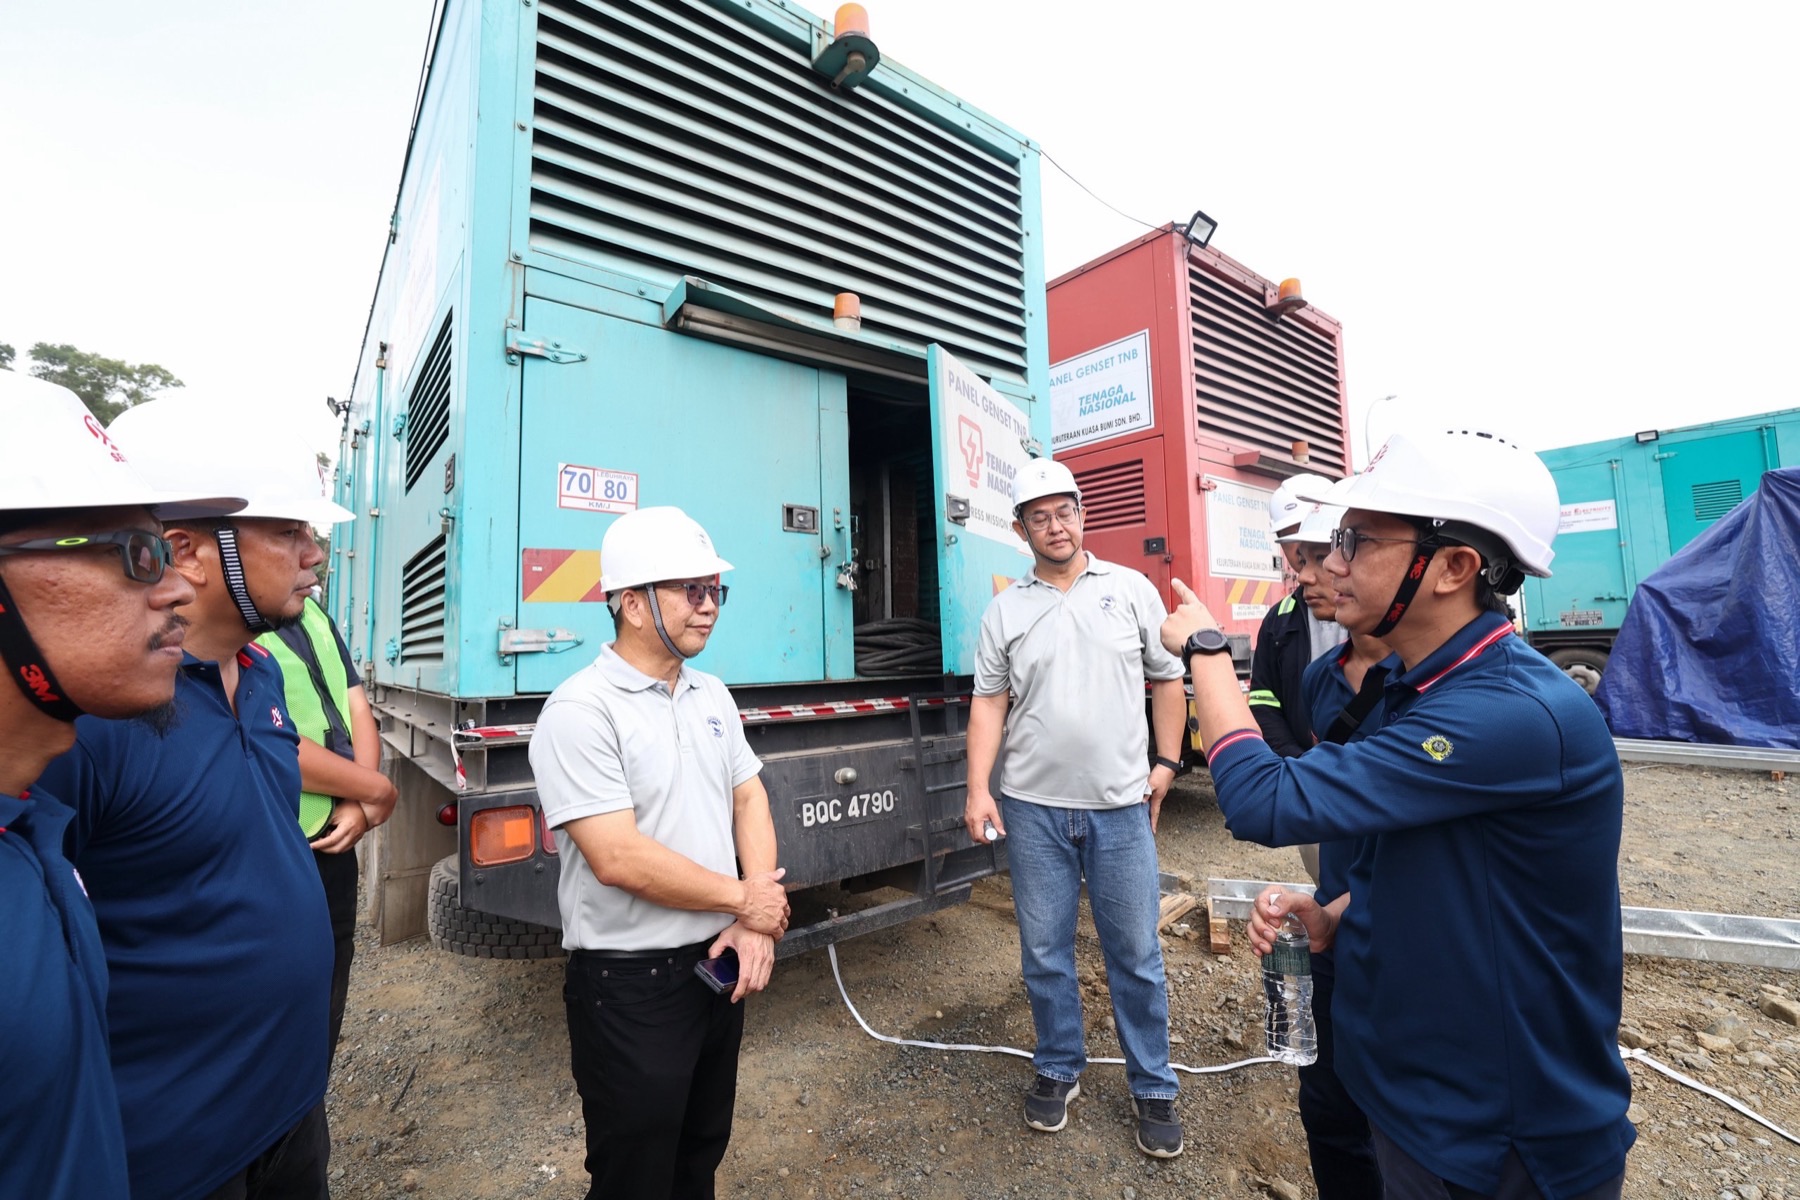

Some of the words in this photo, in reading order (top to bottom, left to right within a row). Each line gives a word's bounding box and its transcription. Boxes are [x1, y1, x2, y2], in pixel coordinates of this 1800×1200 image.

[1050, 371, 1073, 388] ANEL
[1075, 356, 1115, 379] GENSET
[1118, 348, 1138, 365] TNB
[948, 369, 980, 408] PANEL
[981, 394, 1012, 430] GENSET
[1079, 384, 1124, 407] TENAGA
[1079, 391, 1136, 417] NASIONAL
[1051, 430, 1081, 445] URUTERAAN
[1081, 424, 1100, 437] KUASA
[1100, 421, 1114, 431] BUMI
[563, 470, 592, 494] 70
[597, 471, 634, 481] LEBUHRAYA
[987, 471, 1012, 498] NASIO
[604, 480, 627, 500] 80
[970, 506, 985, 521] RESS
[1236, 496, 1260, 511] GENSET
[1261, 501, 1269, 512] TN
[1239, 527, 1265, 539] TENAGA
[1240, 538, 1272, 551] NASIONAL
[20, 663, 60, 702] 3M
[802, 798, 842, 828] BQC
[848, 790, 895, 818] 4790
